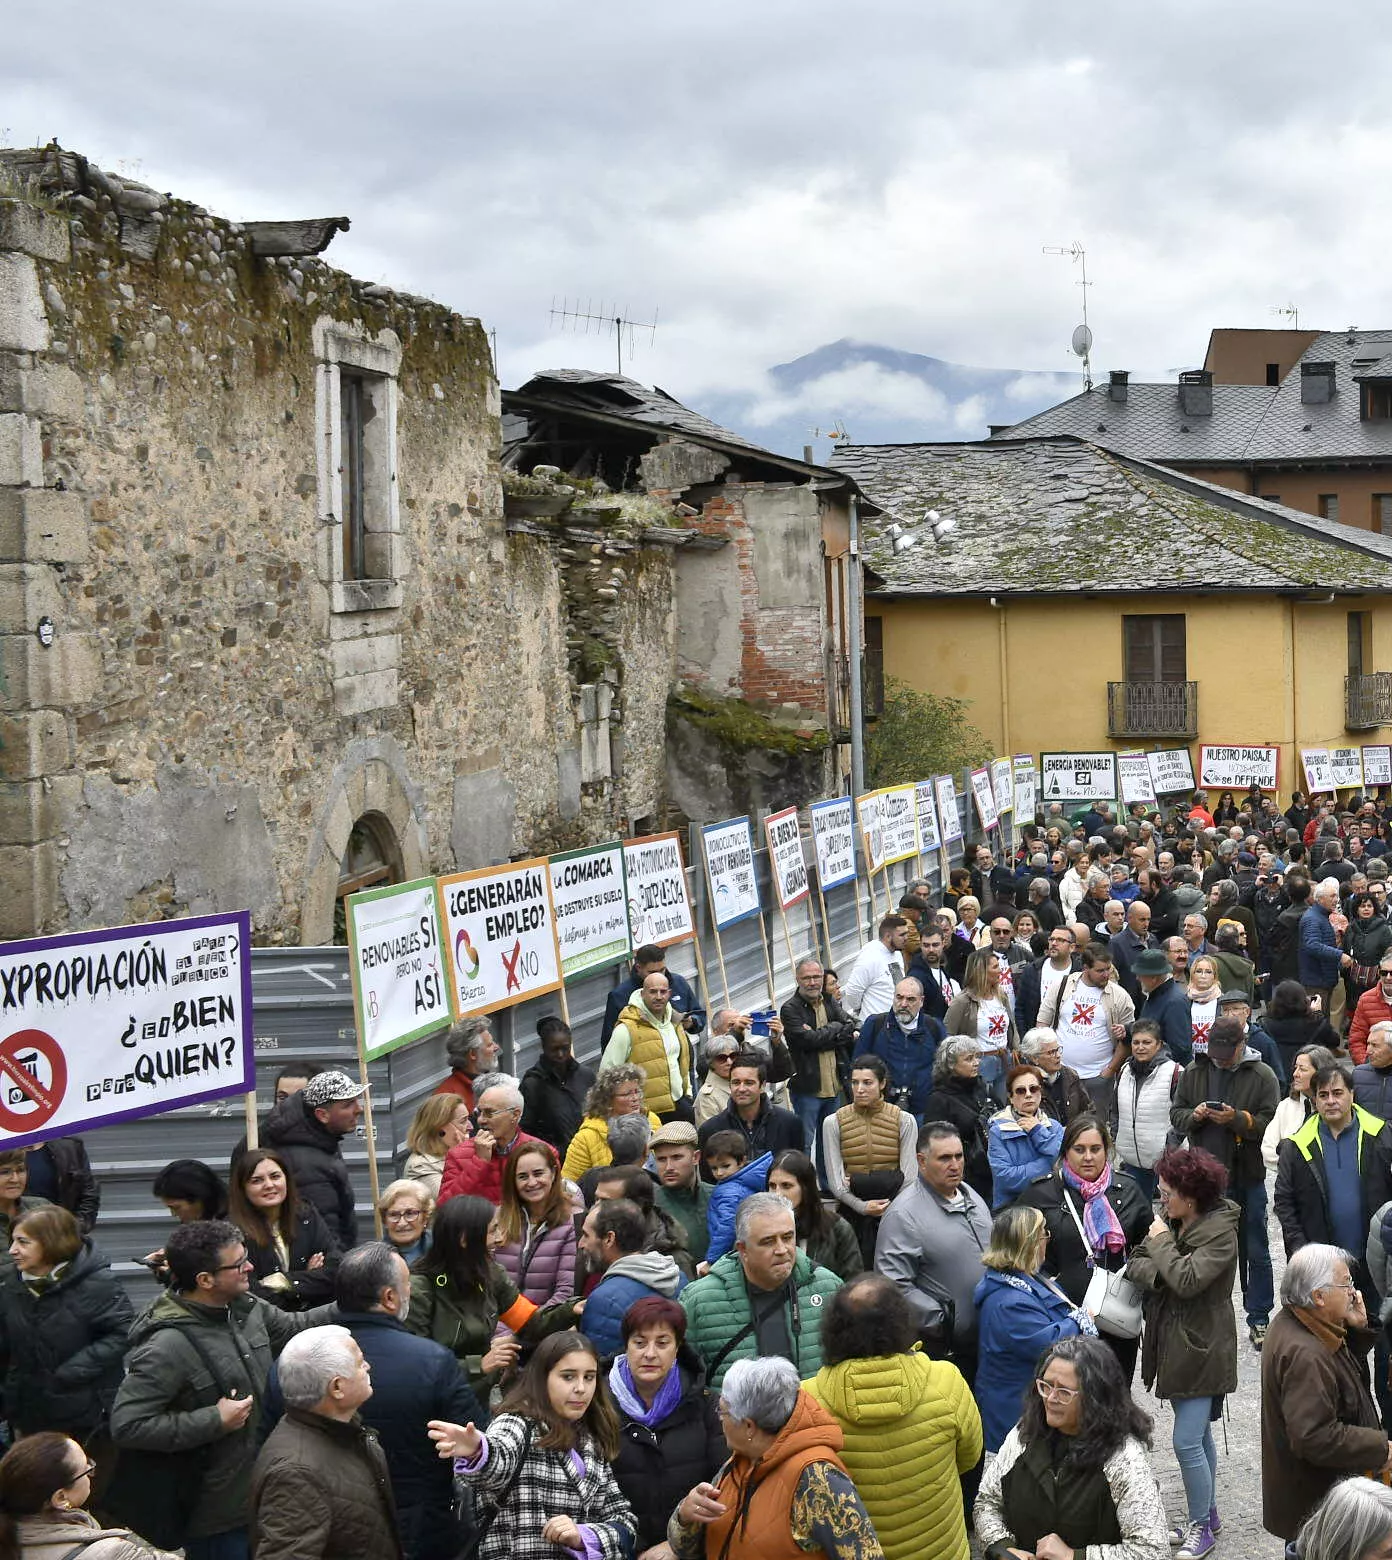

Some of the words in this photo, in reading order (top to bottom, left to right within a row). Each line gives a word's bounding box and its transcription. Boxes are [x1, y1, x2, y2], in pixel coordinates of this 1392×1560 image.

[1074, 758, 1112, 771] RENOVABLE?
[1207, 748, 1240, 761] NUESTRO
[1242, 749, 1272, 762] PAISAJE
[1076, 773, 1090, 784] SI
[1234, 775, 1275, 787] DEFIENDE
[553, 876, 563, 890] LA
[564, 856, 614, 887] COMARCA
[450, 871, 543, 918] ¿GENERARÁN
[555, 905, 564, 919] UE
[564, 895, 594, 917] DESTRUYE
[594, 892, 603, 908] SU
[603, 888, 623, 905] SUELO
[485, 904, 546, 942] EMPLEO?
[193, 936, 226, 951] PARA
[362, 931, 421, 970] RENOVABLES
[0, 940, 168, 1009] XPROPIACIÓN
[176, 955, 193, 970] EL
[198, 950, 227, 966] BIEN
[396, 960, 411, 980] PERO
[411, 957, 422, 972] NO
[520, 950, 540, 980] NO
[172, 995, 236, 1034] BIEN
[87, 1073, 136, 1102] para
[134, 1036, 237, 1086] QUIEN?
